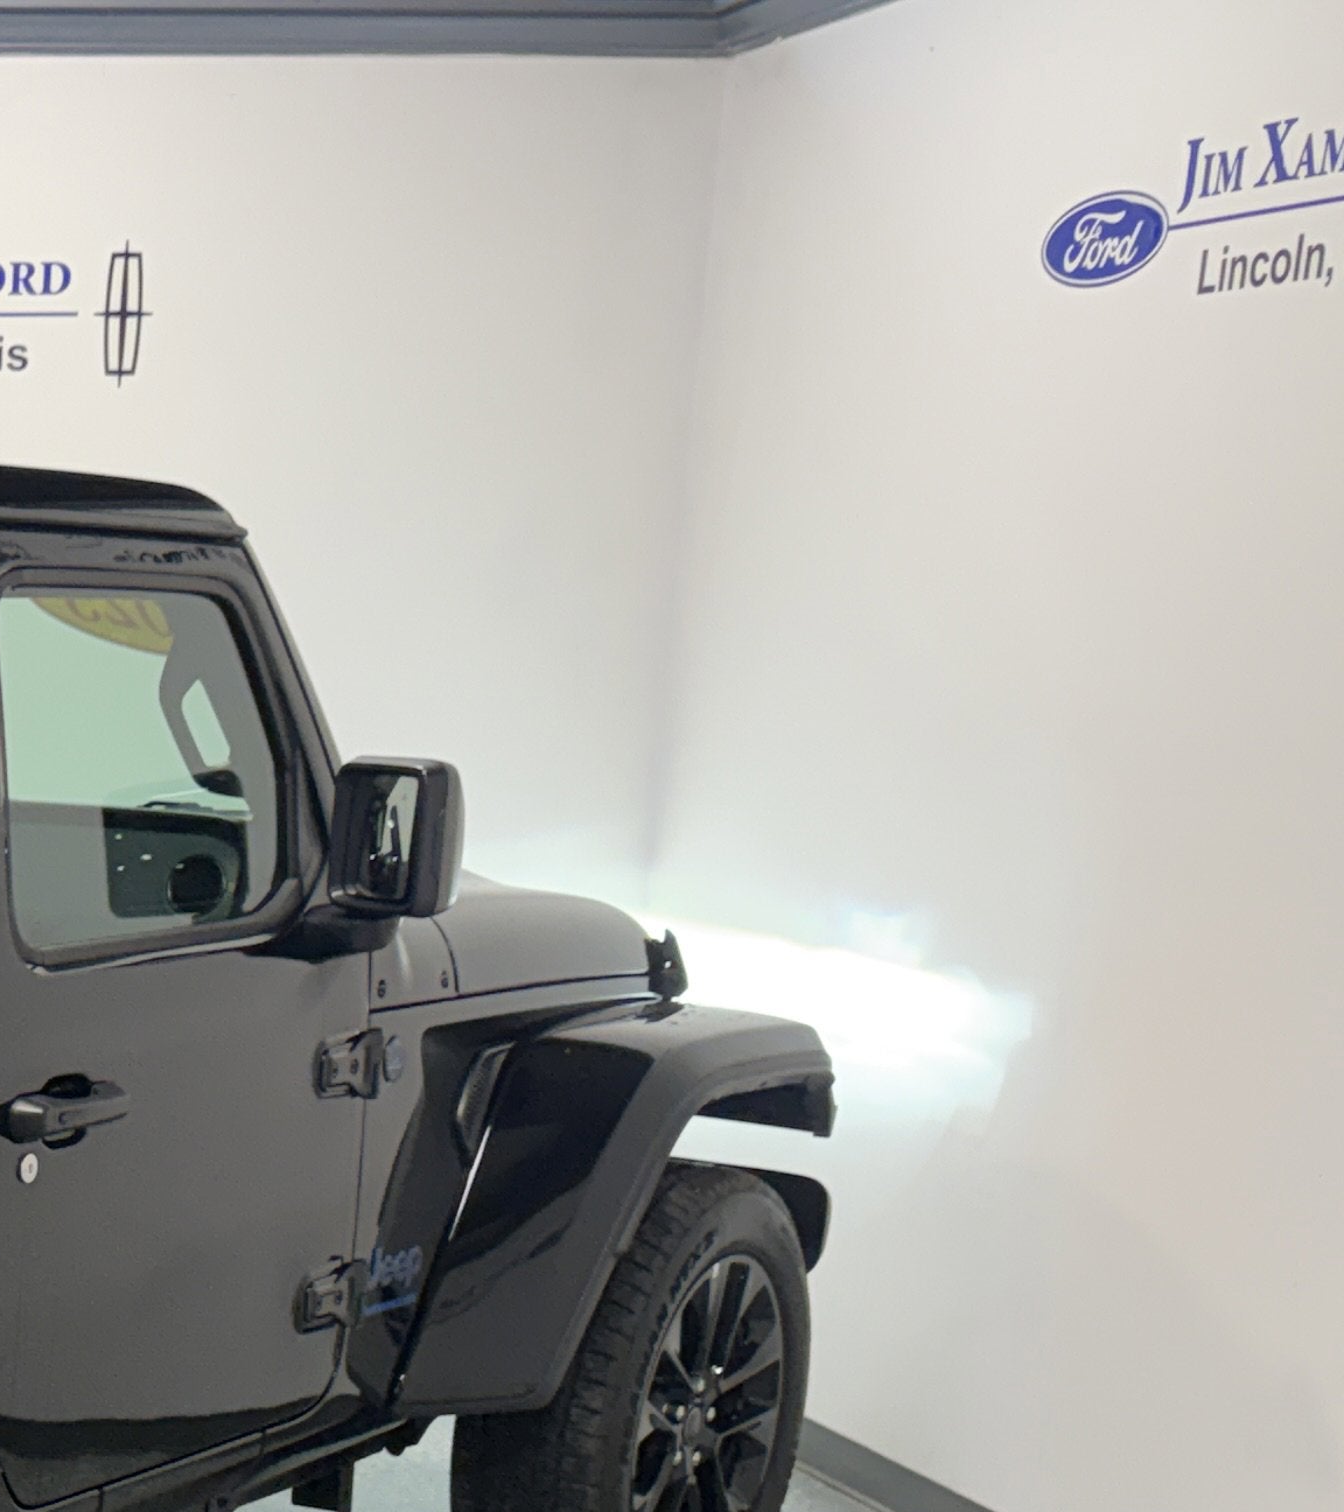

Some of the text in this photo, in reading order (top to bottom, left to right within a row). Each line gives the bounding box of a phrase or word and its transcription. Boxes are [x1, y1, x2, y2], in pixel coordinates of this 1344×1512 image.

[1177, 137, 1249, 214] JIM
[1063, 210, 1145, 274] Ford
[1197, 233, 1334, 295] Lincoln,
